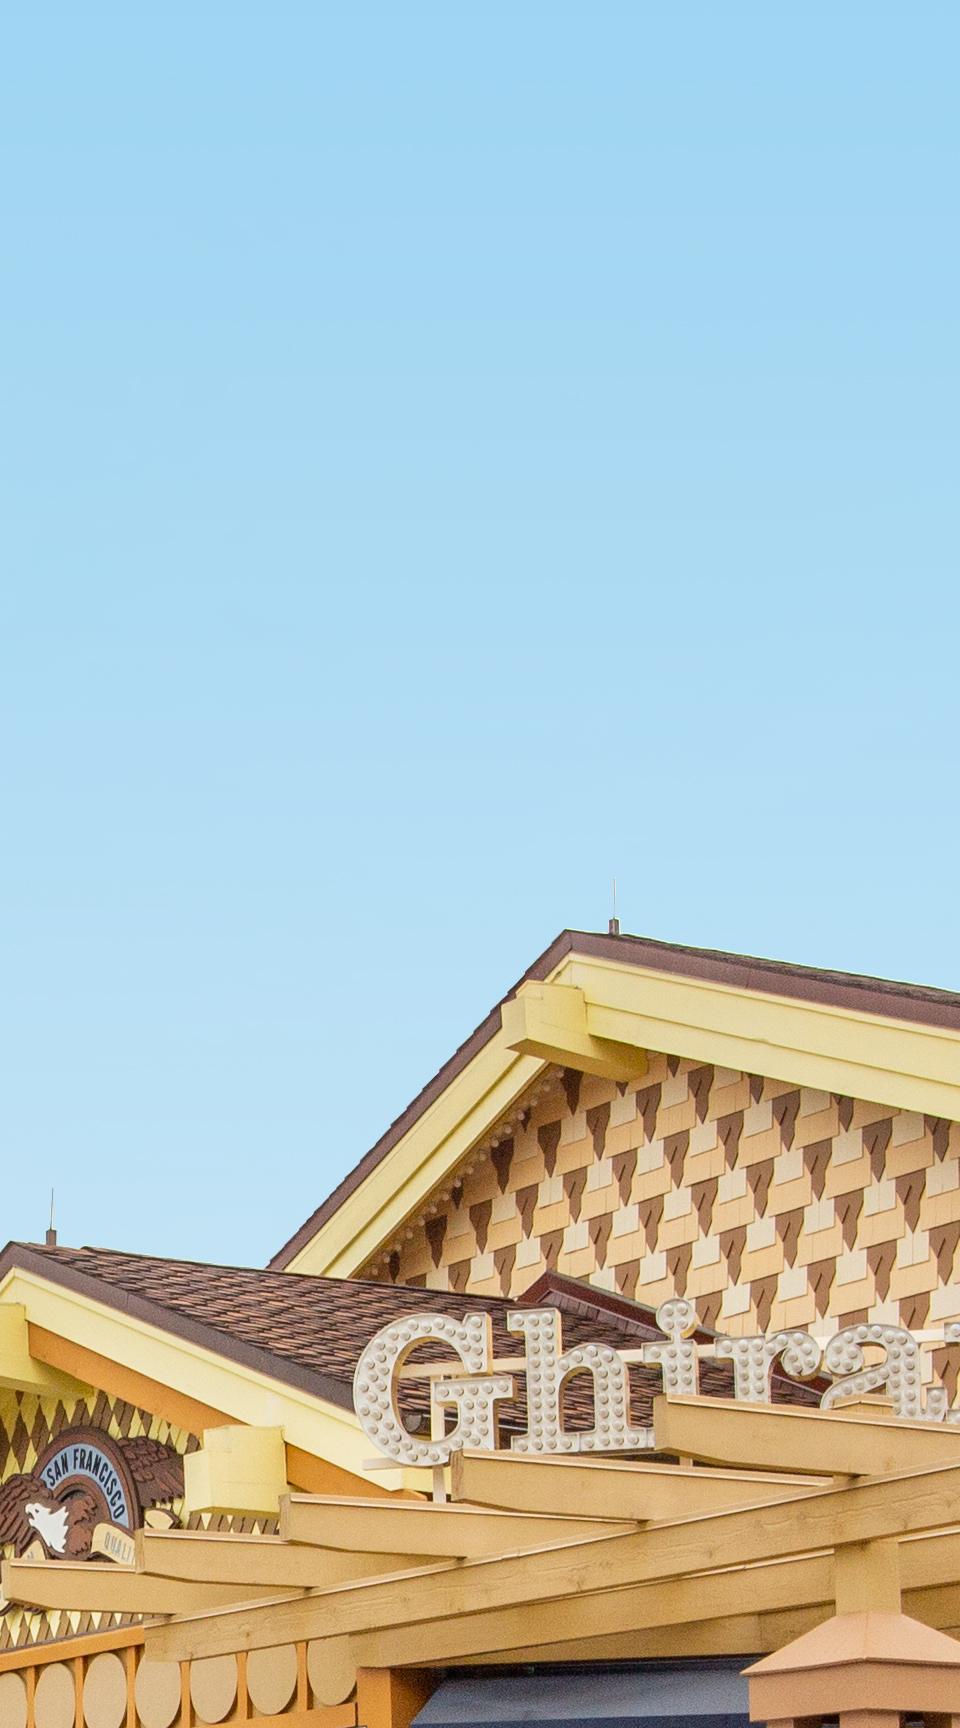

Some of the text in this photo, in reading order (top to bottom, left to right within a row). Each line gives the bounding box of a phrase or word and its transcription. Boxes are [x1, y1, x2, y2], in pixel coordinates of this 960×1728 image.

[353, 1298, 960, 1467] Ghira
[46, 1448, 127, 1520] SAN FRANCISCO
